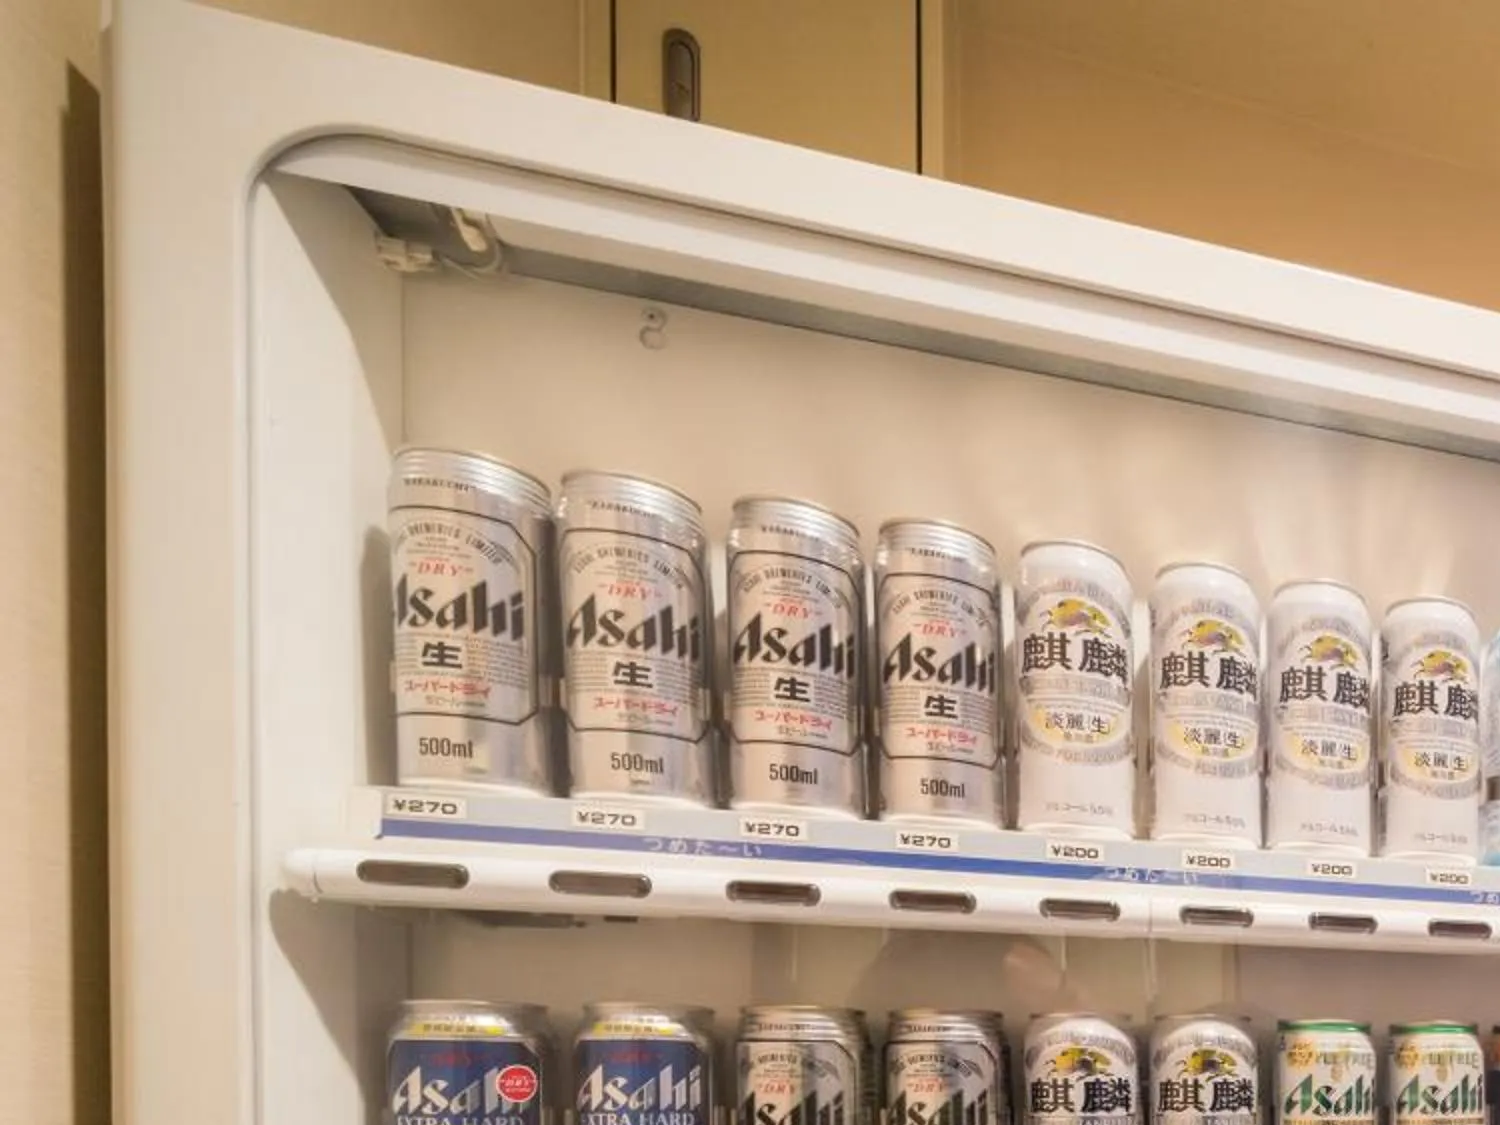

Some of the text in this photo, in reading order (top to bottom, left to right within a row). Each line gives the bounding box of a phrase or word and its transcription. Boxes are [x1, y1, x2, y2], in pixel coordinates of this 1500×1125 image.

[394, 573, 524, 641] Asahi
[566, 594, 699, 665] Asahi
[421, 641, 463, 669] 生
[732, 611, 855, 680] Asahi
[883, 632, 996, 696] Asahi
[1021, 631, 1129, 690] 麒麟
[1159, 650, 1257, 695] 麒麟
[613, 660, 654, 689] 生
[773, 676, 811, 703] 生
[1279, 666, 1371, 711] 麒麟
[923, 695, 959, 720] 生
[418, 736, 474, 759] 500ml
[610, 751, 665, 776] 500ml
[768, 763, 819, 786] 500ml
[920, 777, 966, 800] 500ml
[393, 798, 458, 816] ¥270
[576, 811, 638, 828] ¥270
[745, 821, 801, 838] ¥270
[899, 833, 952, 850] ¥270
[1050, 845, 1100, 860] ¥200
[1186, 855, 1232, 869] ¥200
[1311, 863, 1354, 877] ¥200
[576, 1063, 702, 1114] Asahi
[1030, 1077, 1132, 1114] 麒麟
[1158, 1077, 1255, 1114] 麒麟
[1396, 1073, 1484, 1116] Asahi
